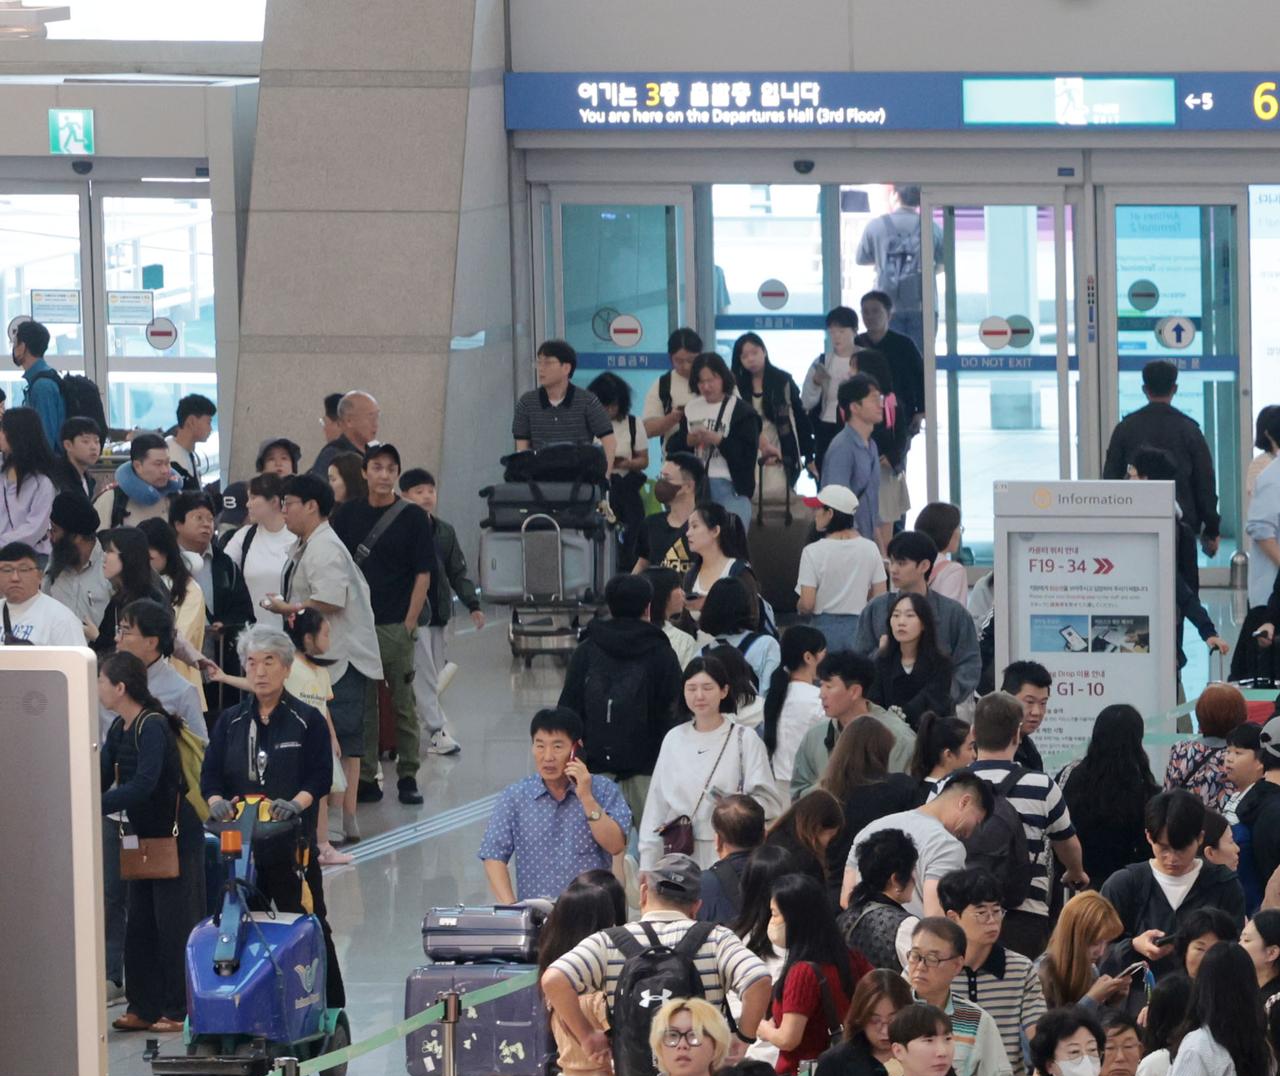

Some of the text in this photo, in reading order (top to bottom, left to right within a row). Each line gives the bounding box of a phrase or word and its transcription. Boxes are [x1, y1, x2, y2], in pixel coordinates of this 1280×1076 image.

[578, 82, 637, 107] 여기는
[761, 81, 821, 107] 입니다
[1202, 93, 1213, 110] 5
[1253, 82, 1279, 120] 6
[579, 107, 886, 126] You are here on the Departures Hall (3rd Floor)
[961, 357, 1033, 368] DO NOT EXIT
[1058, 493, 1133, 506] Information
[1029, 558, 1055, 573] F19
[1067, 558, 1087, 573] 34
[1057, 682, 1074, 696] G1
[1087, 682, 1105, 696] 10
